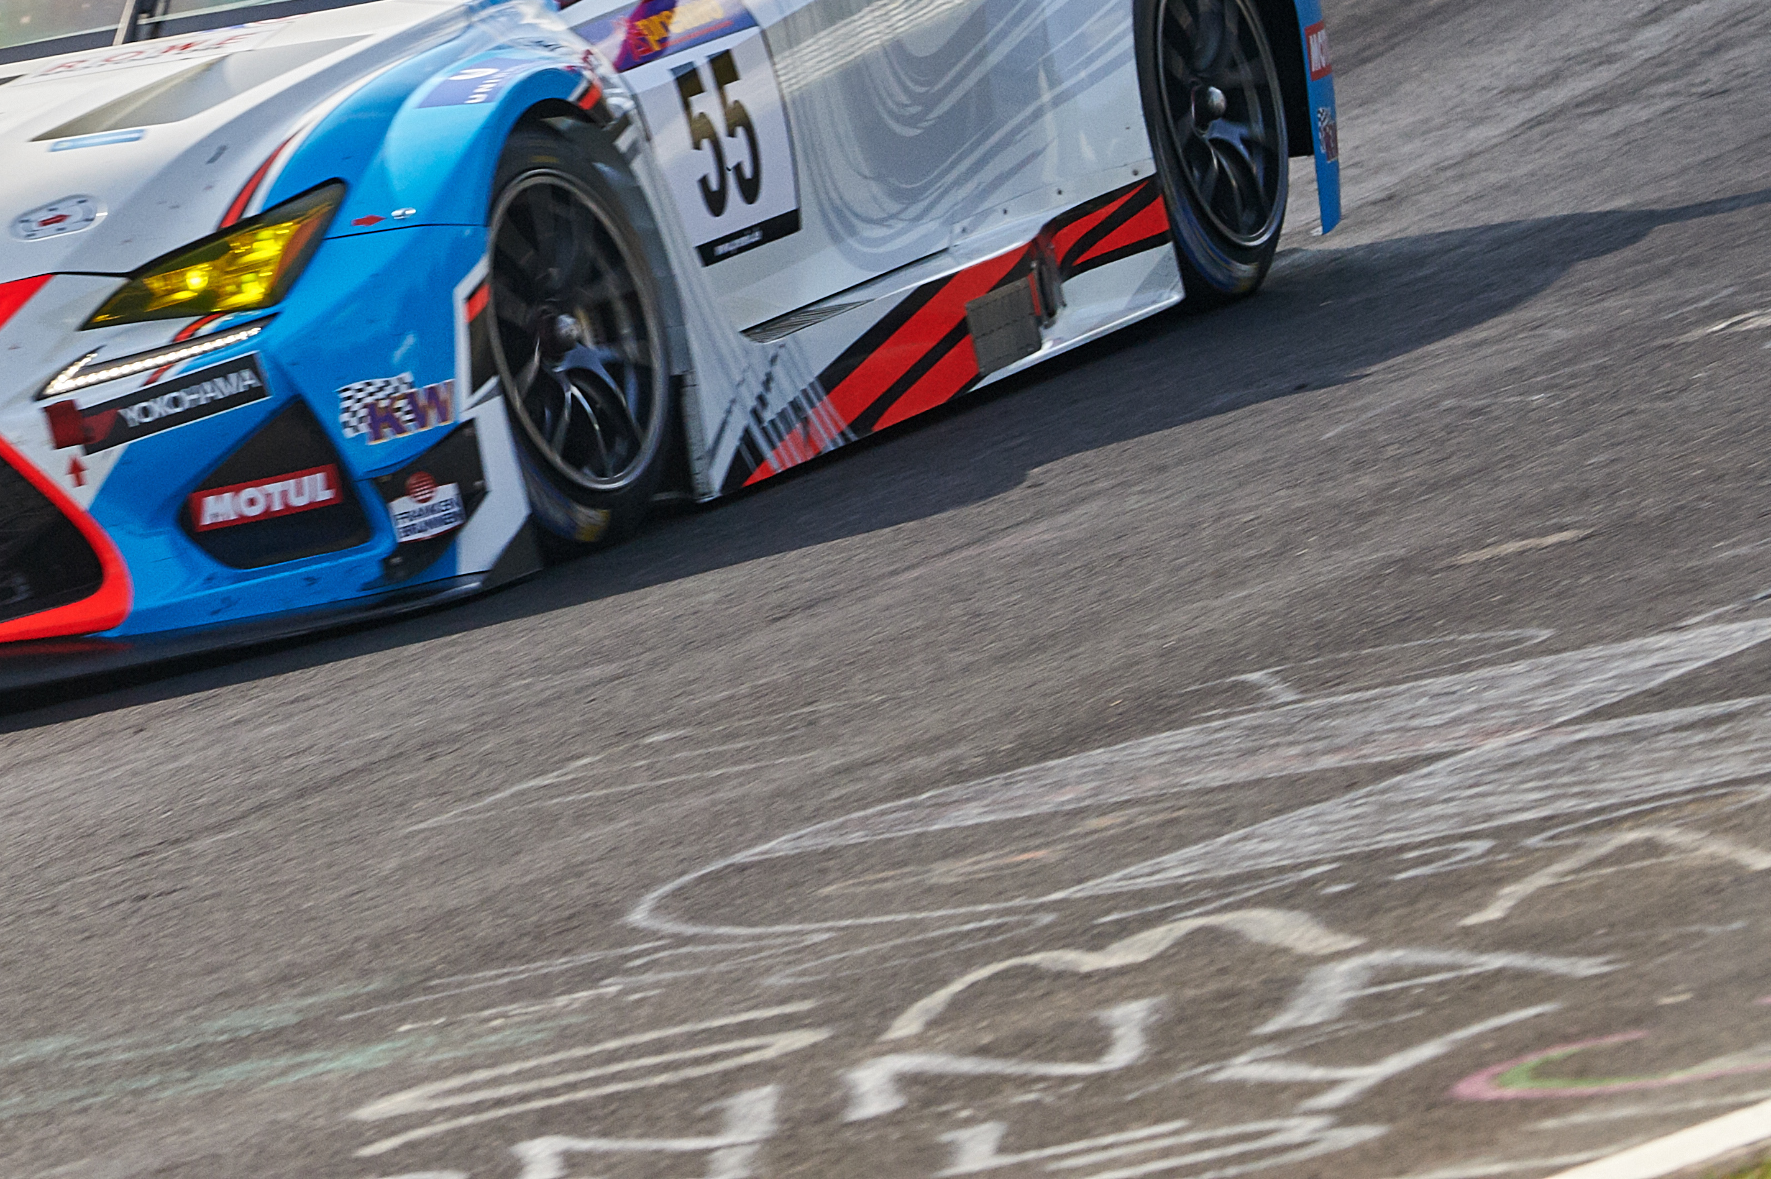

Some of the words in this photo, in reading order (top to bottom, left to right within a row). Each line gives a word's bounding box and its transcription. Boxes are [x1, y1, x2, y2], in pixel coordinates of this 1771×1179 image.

[669, 49, 762, 217] 55
[117, 367, 263, 428] YOKOHAMA
[200, 471, 336, 526] MOTUL
